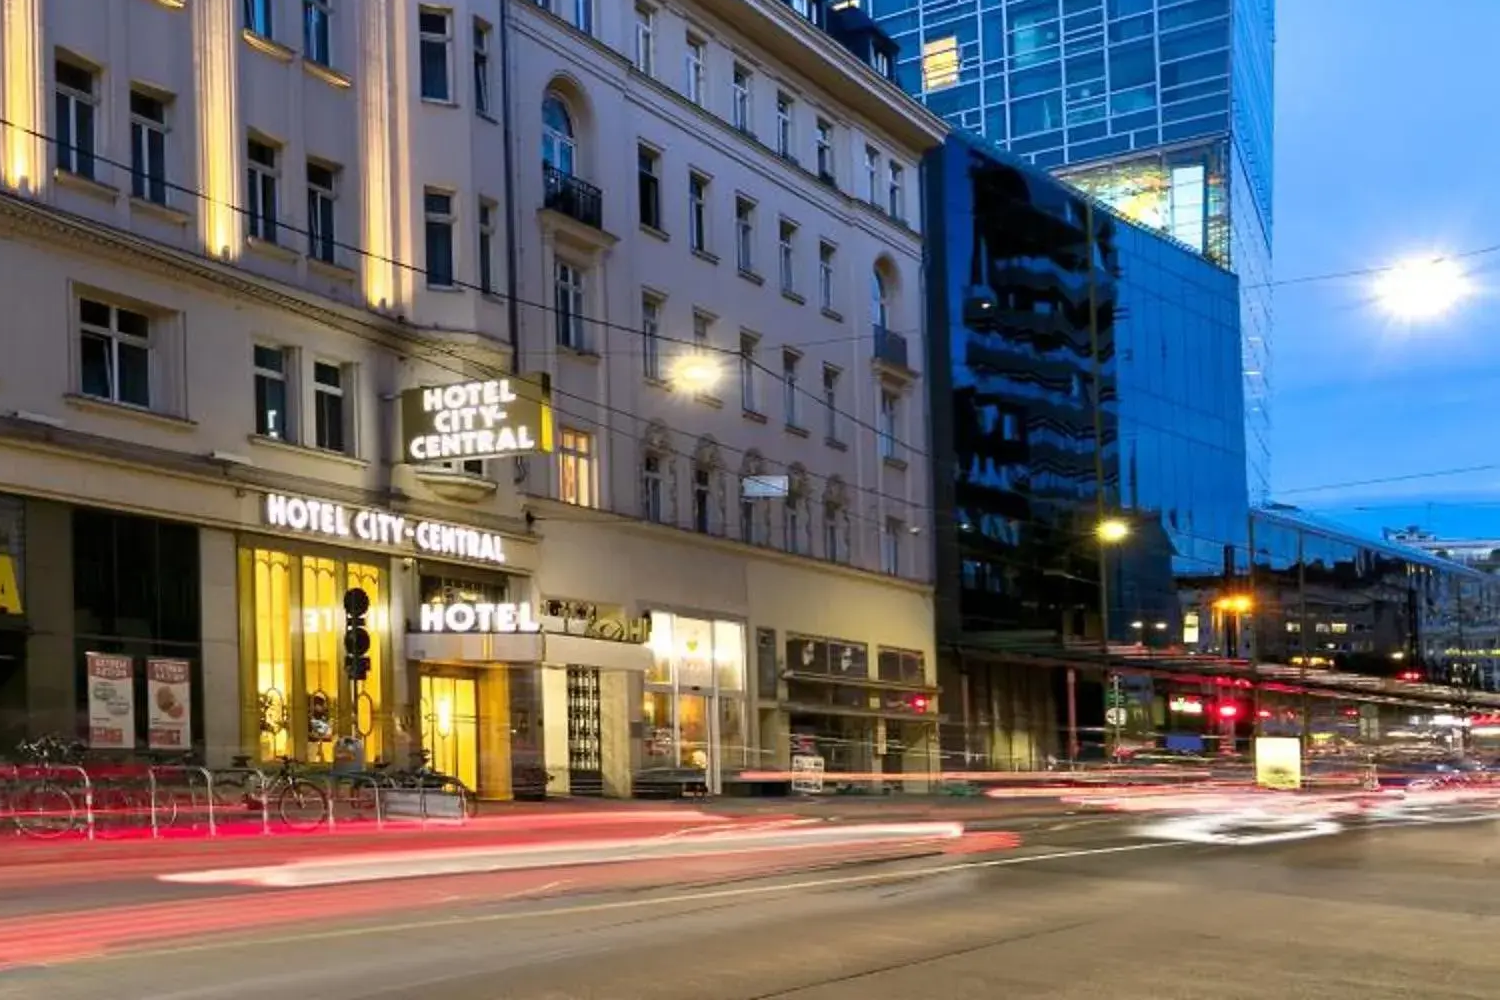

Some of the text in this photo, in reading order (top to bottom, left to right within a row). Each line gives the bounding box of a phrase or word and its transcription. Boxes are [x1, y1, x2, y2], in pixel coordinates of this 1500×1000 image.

[423, 378, 517, 412] HOTEL
[409, 425, 536, 460] CENTRAL
[267, 493, 349, 536] HOTEL
[420, 602, 540, 632] HOTEL
